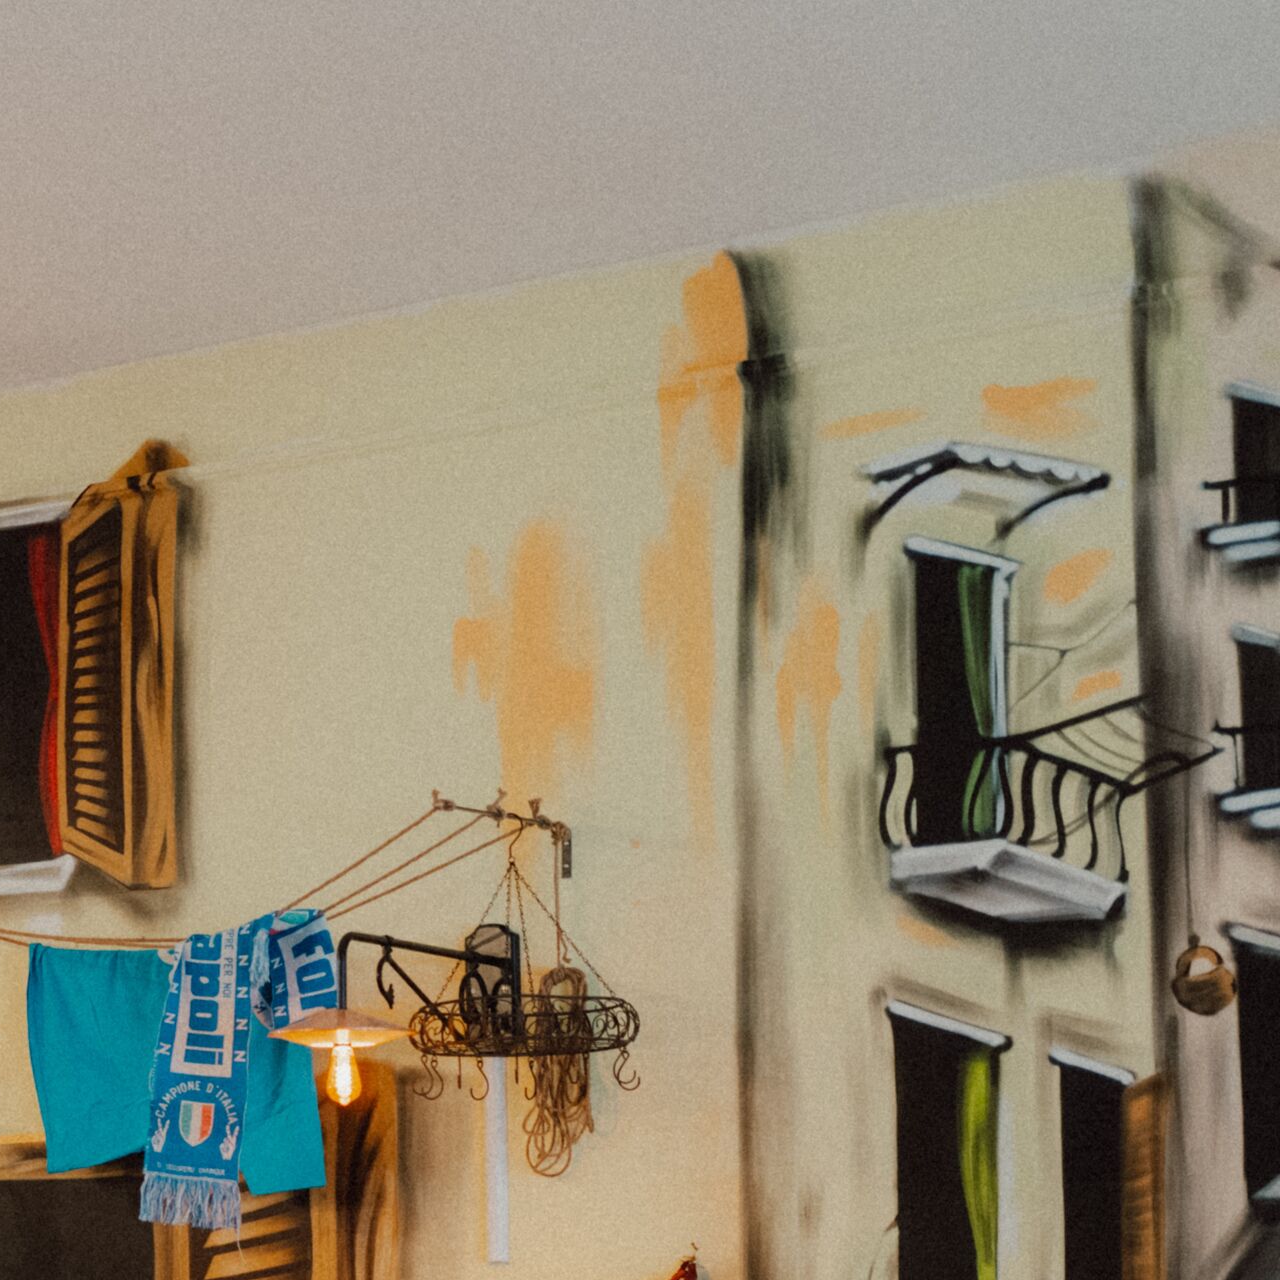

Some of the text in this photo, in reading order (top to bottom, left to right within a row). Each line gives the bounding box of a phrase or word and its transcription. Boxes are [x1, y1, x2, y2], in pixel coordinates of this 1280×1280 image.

[223, 956, 234, 977] PER
[184, 933, 225, 1066] apoli
[222, 982, 232, 999] NOI
[155, 1080, 239, 1124] CAMPIONE D'ITALIA
